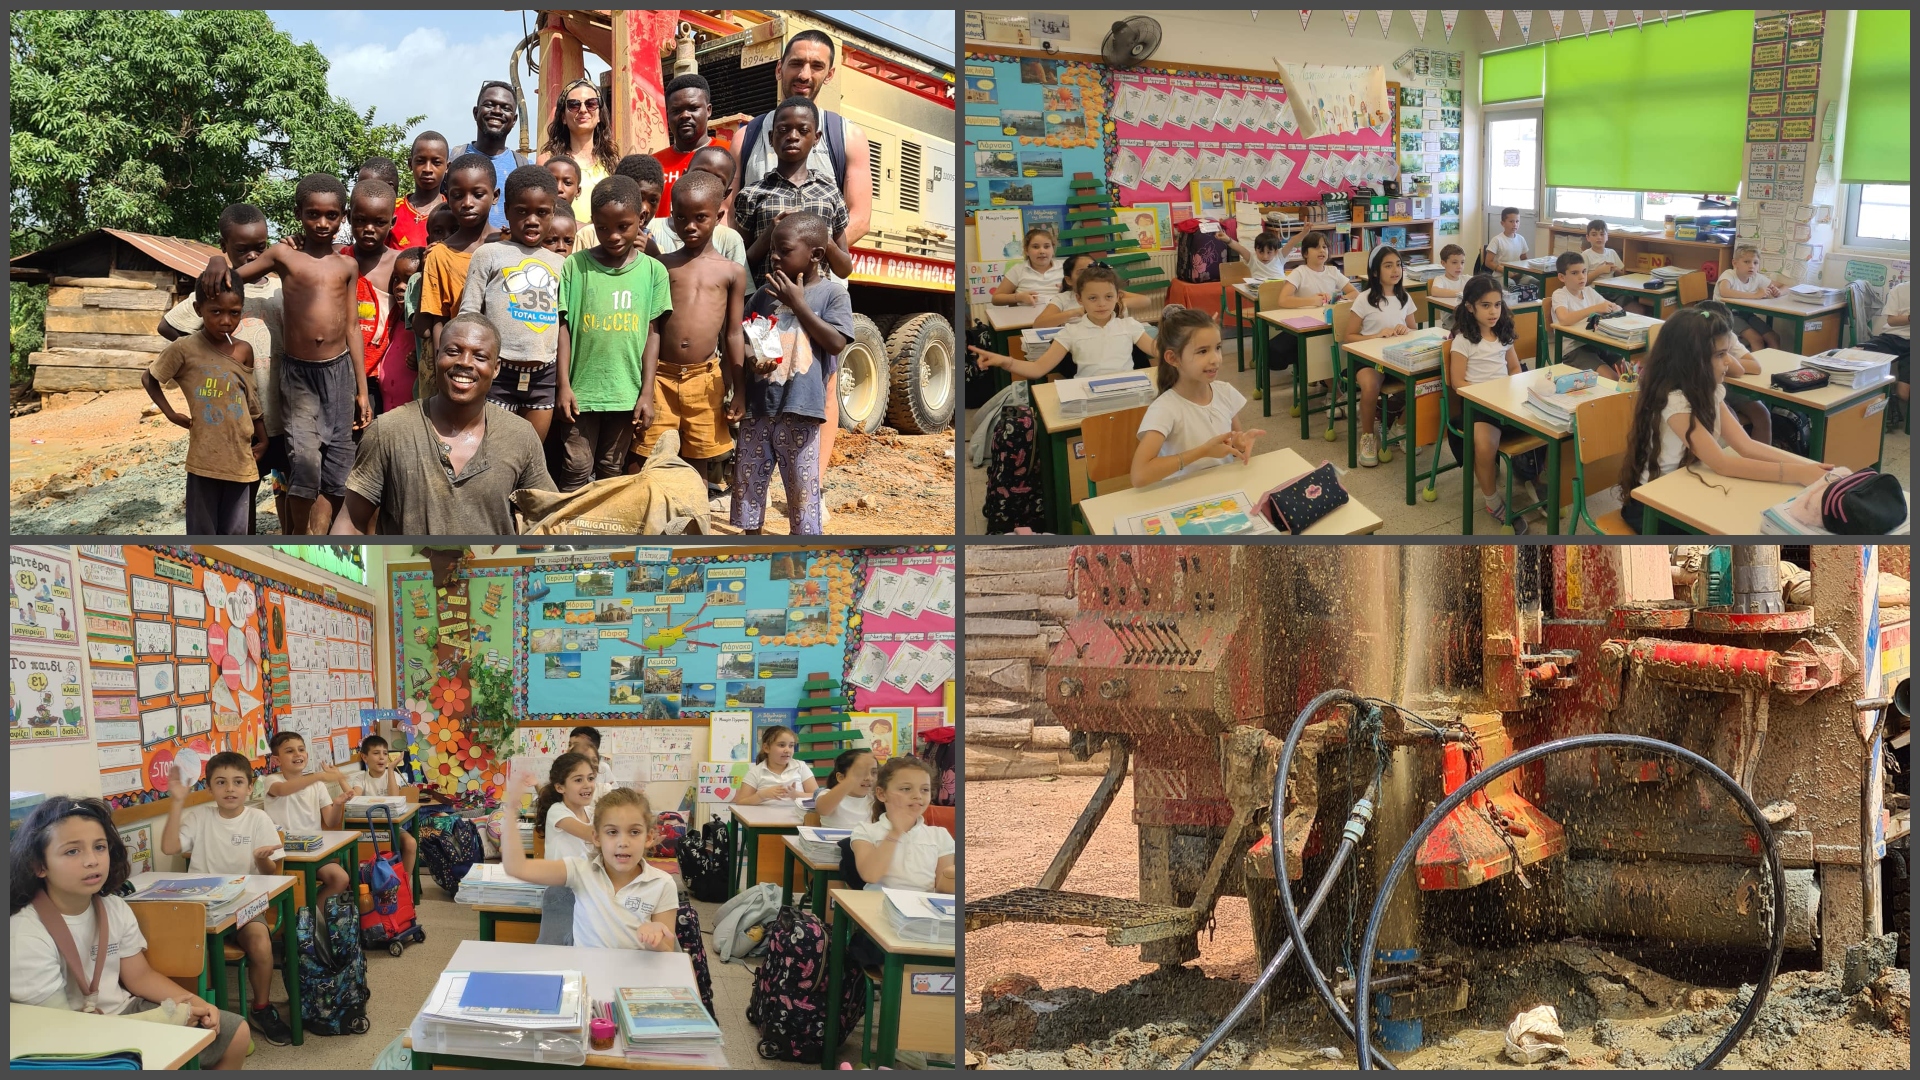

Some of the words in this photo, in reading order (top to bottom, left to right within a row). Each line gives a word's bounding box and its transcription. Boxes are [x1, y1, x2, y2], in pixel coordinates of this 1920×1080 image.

[979, 142, 1010, 150] Λάρνακα
[987, 264, 998, 272] ΣΕ
[972, 286, 986, 294] ΣΕ
[522, 290, 551, 312] 35
[612, 290, 632, 310] 10
[512, 310, 537, 321] TOTAL
[576, 519, 625, 532] IRRIGATION
[10, 555, 51, 573] μητέρα
[20, 573, 34, 586] ει
[546, 574, 572, 582] Κερύνεια
[566, 600, 593, 608] Μόρφου
[14, 628, 44, 636] μαγειρεύει
[601, 630, 628, 638] Πάφος
[10, 658, 26, 670] Το
[30, 660, 62, 672] παιδί
[648, 658, 676, 666] Λεμεσός
[32, 676, 45, 686] ει
[62, 728, 84, 736] διαβάζει
[715, 764, 725, 773] ΣΕ
[700, 786, 712, 794] ΣΕ
